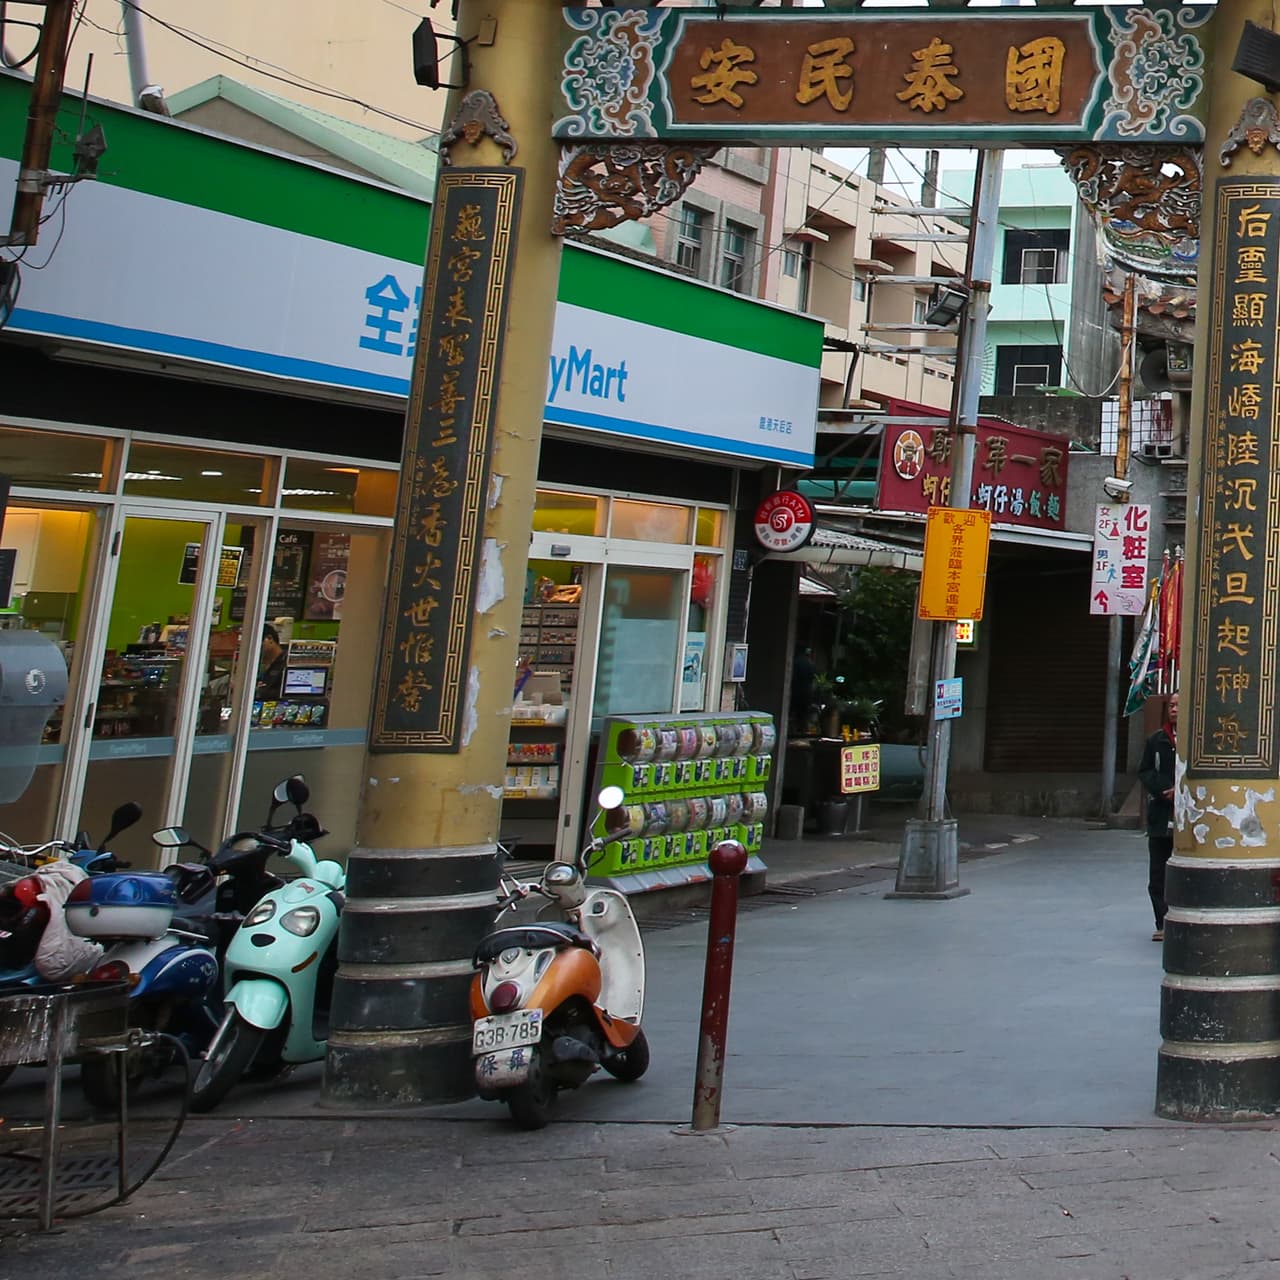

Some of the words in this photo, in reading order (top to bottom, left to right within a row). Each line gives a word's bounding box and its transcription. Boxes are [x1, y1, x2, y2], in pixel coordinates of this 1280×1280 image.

[691, 36, 1066, 114] 國泰民安
[1099, 519, 1111, 529] 2F
[1096, 561, 1108, 571] 1F
